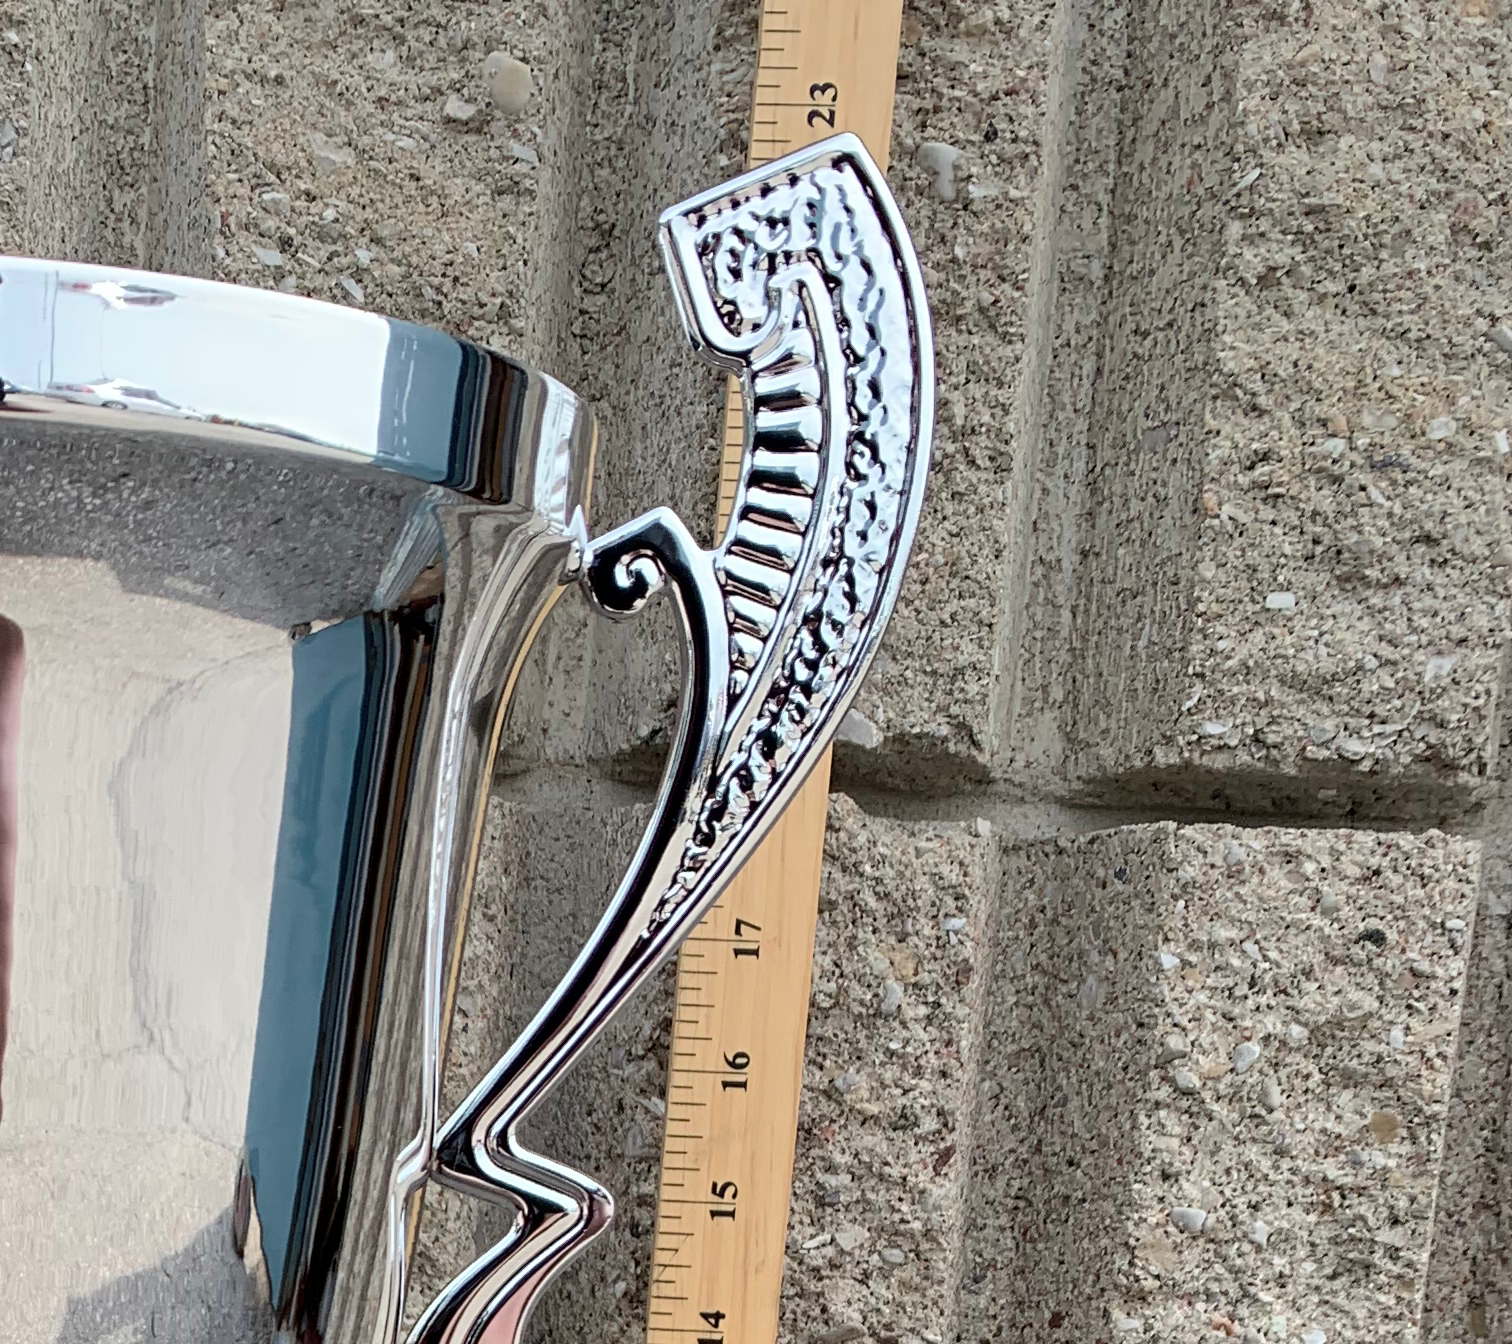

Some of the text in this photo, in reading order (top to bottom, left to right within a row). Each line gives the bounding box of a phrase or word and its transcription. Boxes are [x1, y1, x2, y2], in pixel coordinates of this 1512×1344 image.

[807, 82, 838, 128] 23
[733, 918, 762, 960] 17
[722, 1051, 751, 1093] 16
[710, 1181, 738, 1221] 15
